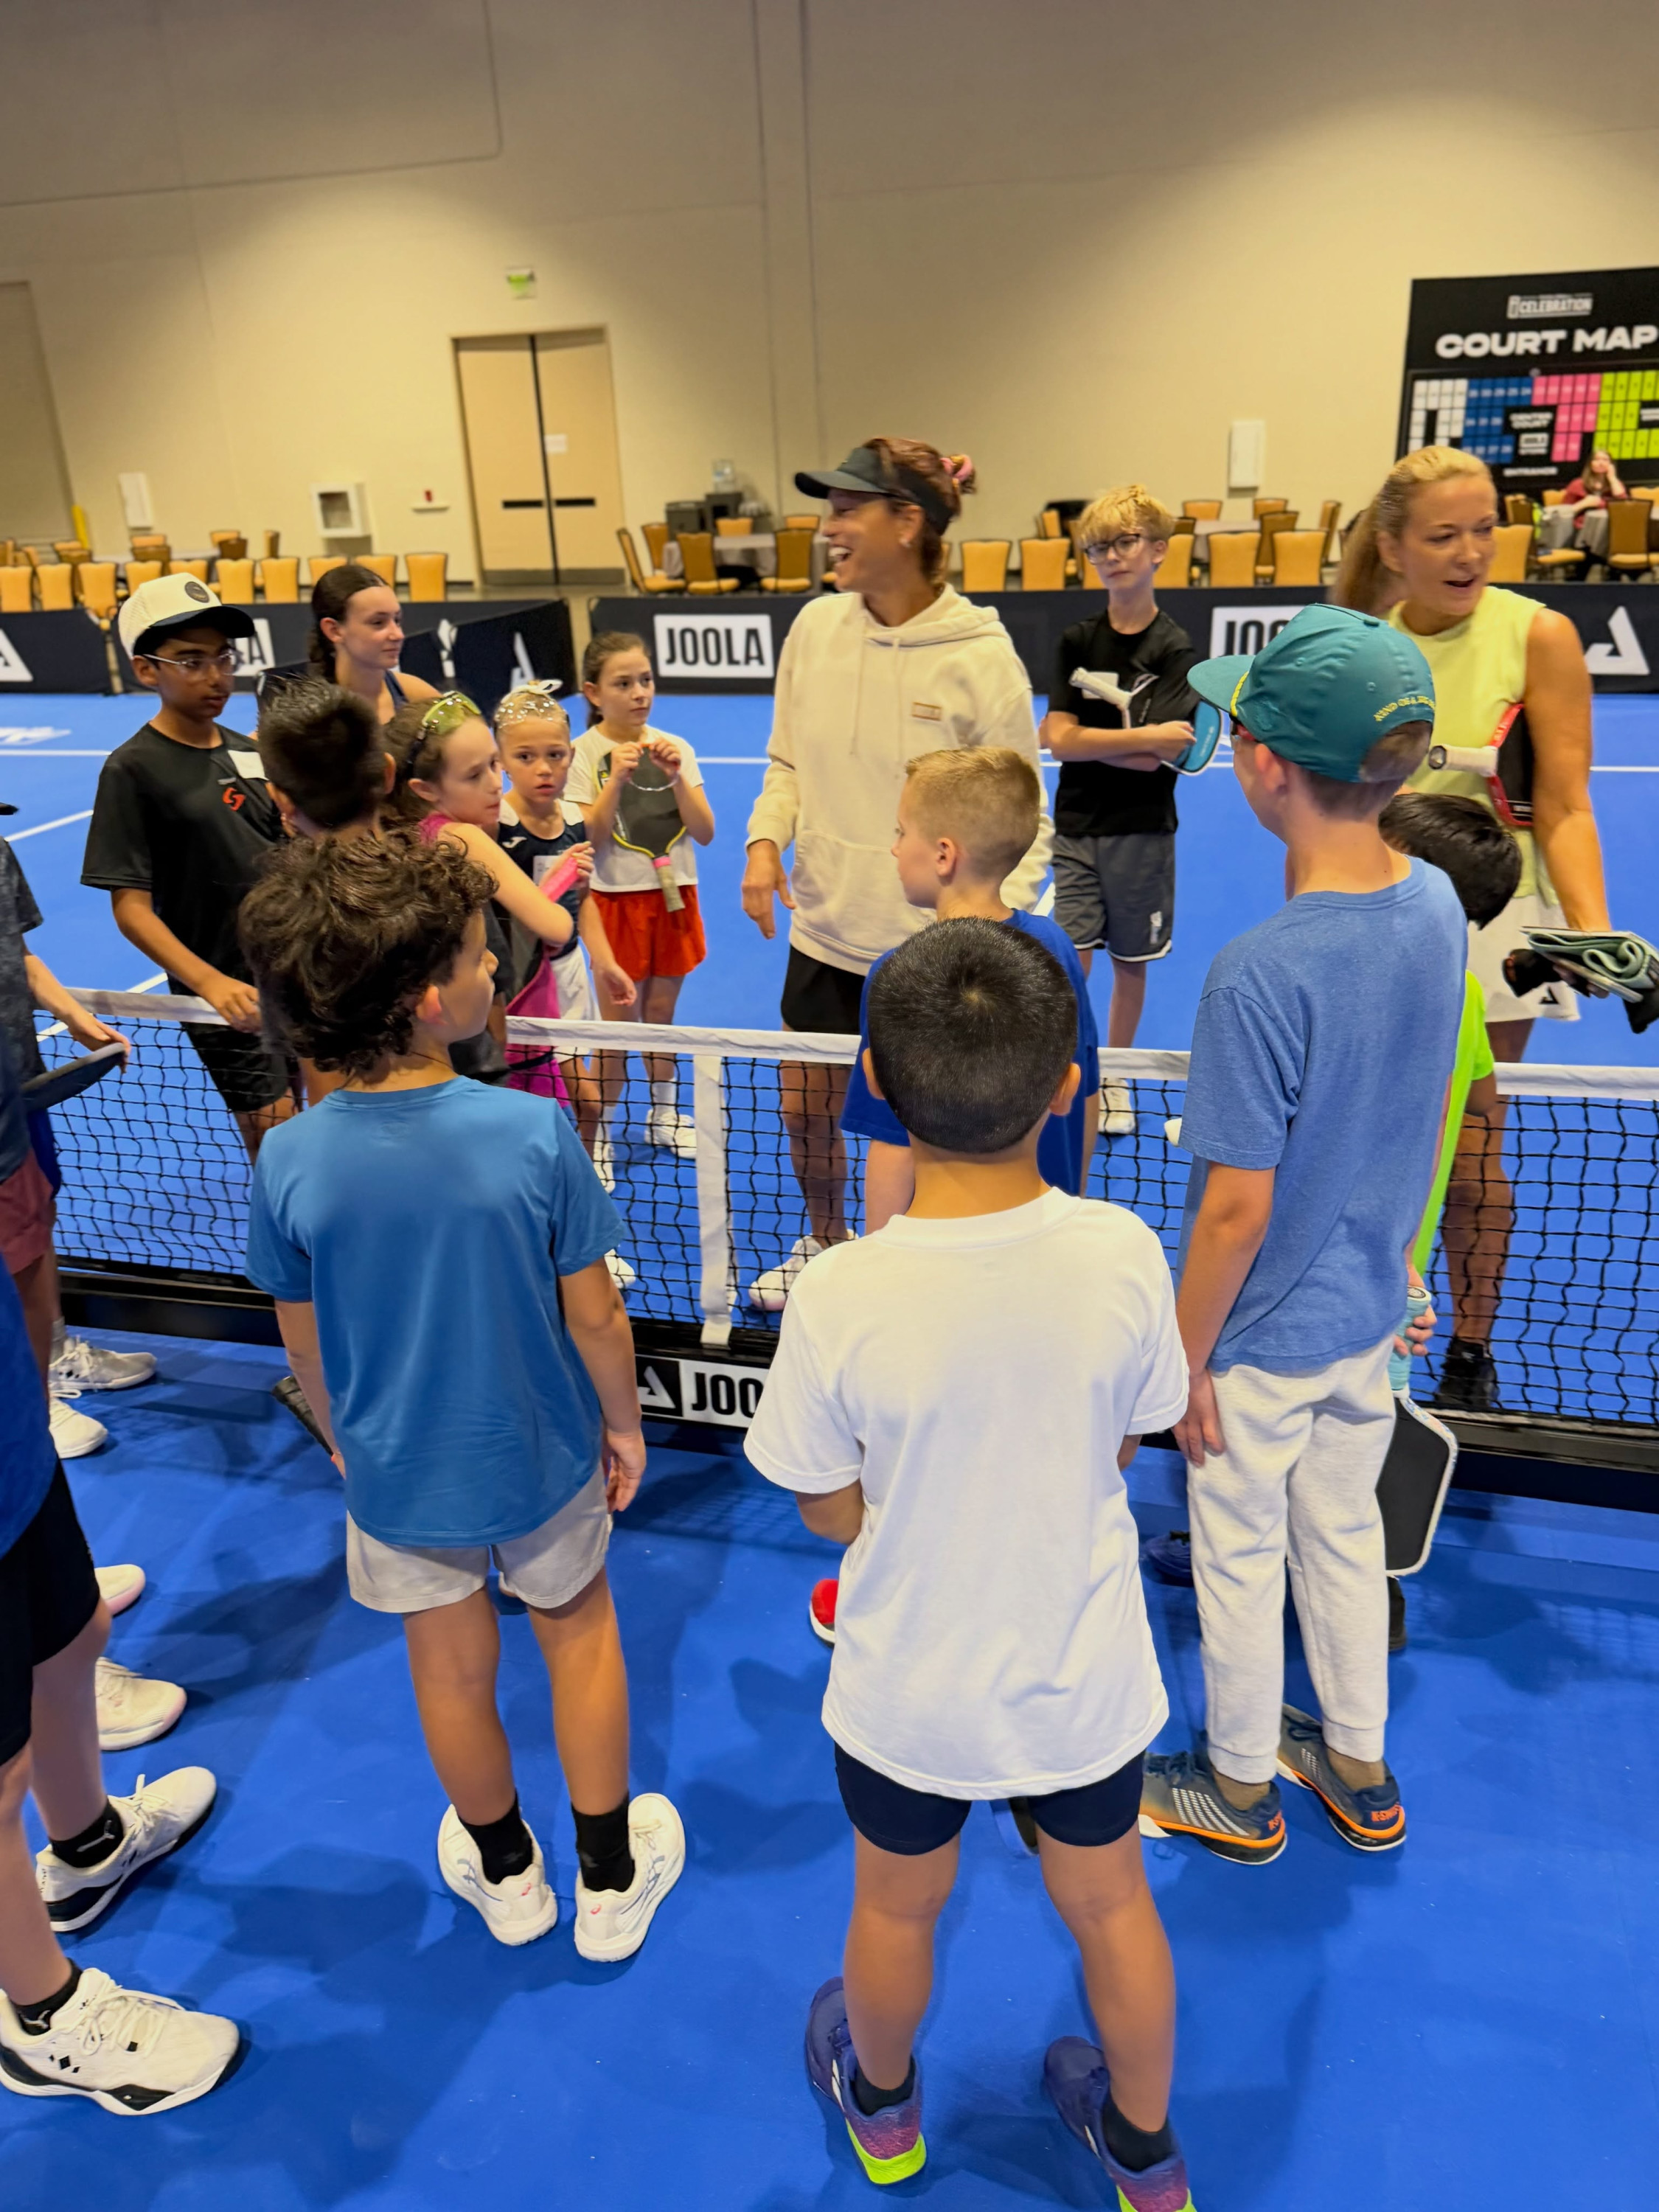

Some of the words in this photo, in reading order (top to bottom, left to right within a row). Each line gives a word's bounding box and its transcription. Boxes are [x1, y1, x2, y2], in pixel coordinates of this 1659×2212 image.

[1435, 331, 1567, 359] COURT
[1573, 324, 1659, 353] MAP
[666, 627, 765, 666] JOOLA
[691, 1371, 764, 1419] JOO
